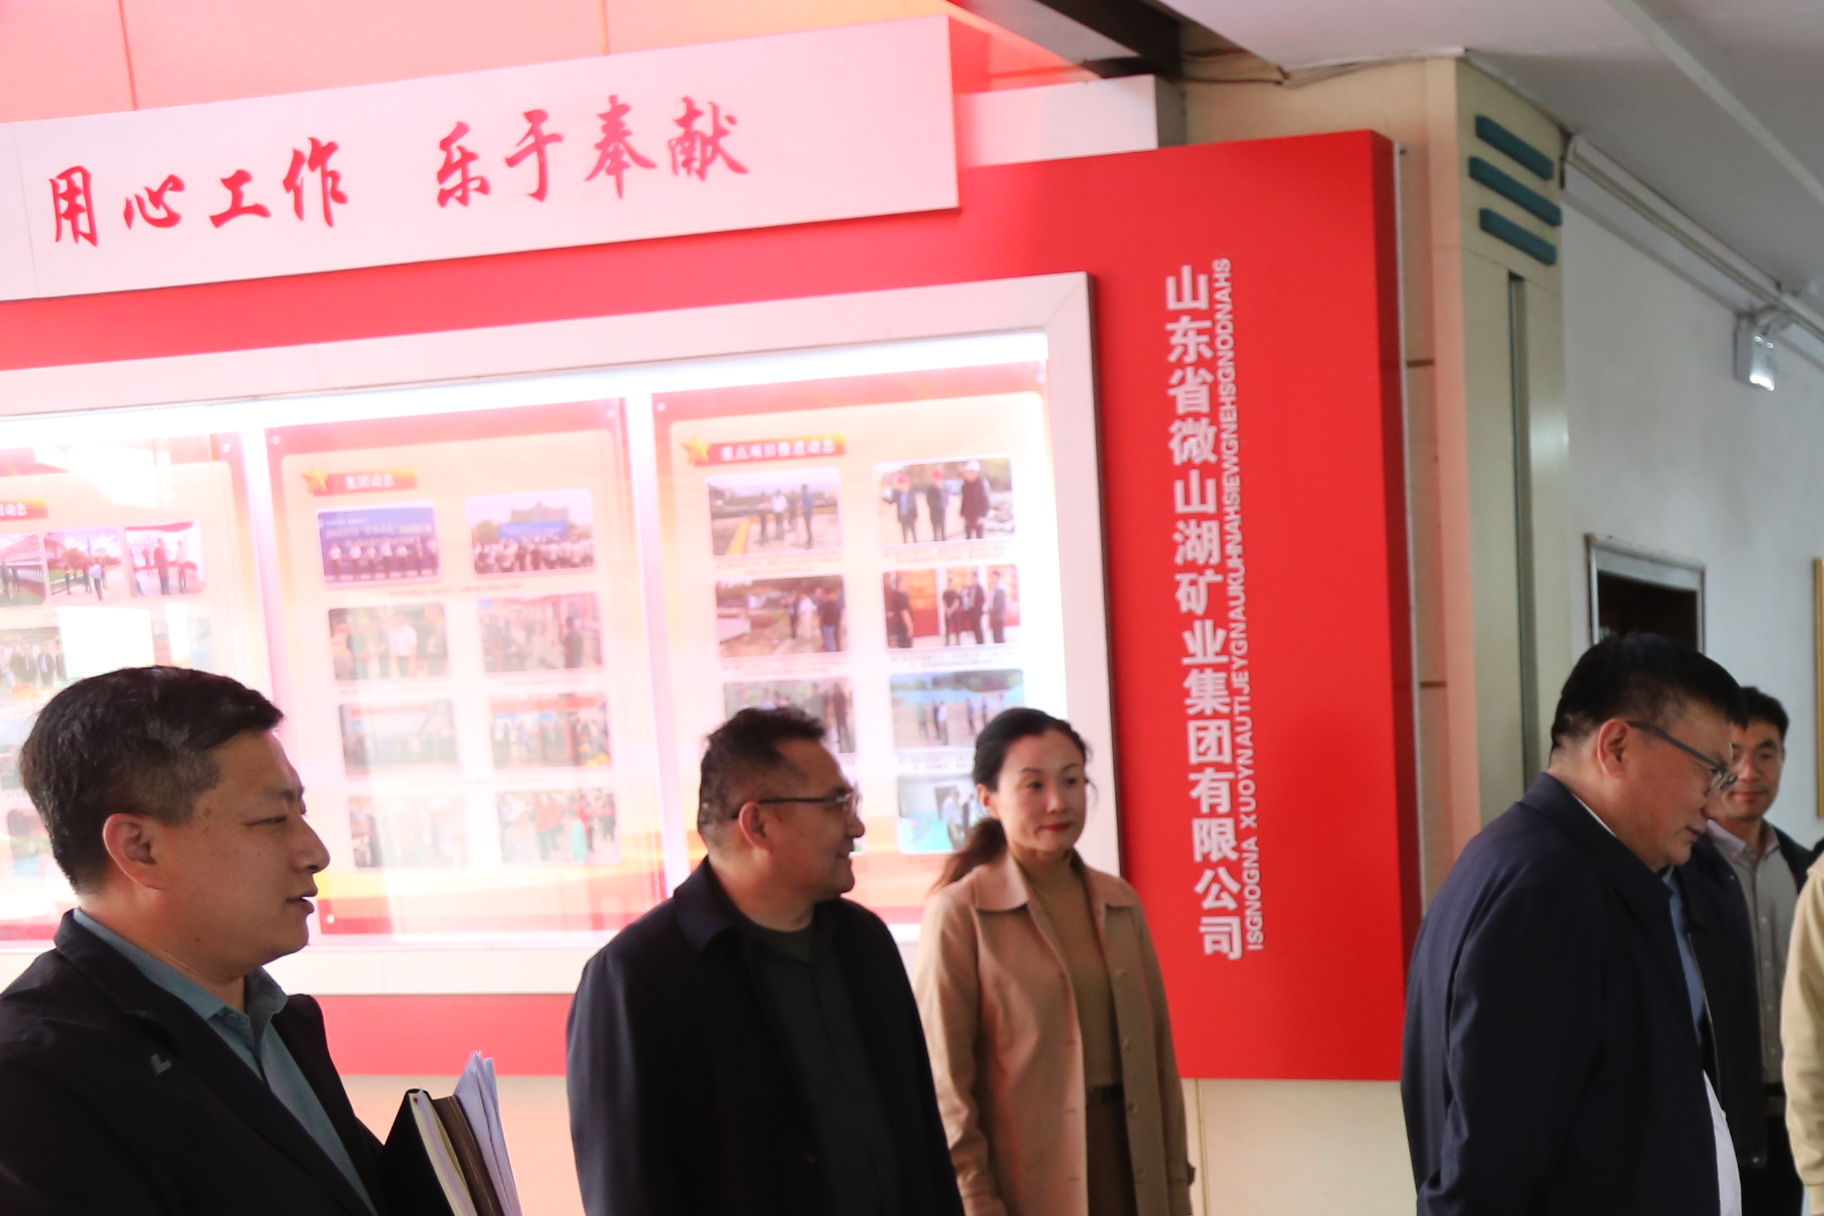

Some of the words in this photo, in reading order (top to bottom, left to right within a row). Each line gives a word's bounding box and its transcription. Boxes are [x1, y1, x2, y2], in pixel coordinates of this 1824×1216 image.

[48, 136, 349, 248] 用心工作
[434, 94, 750, 208] 乐于奉献
[1165, 264, 1243, 960] 山东省微山湖矿业集团有限公司
